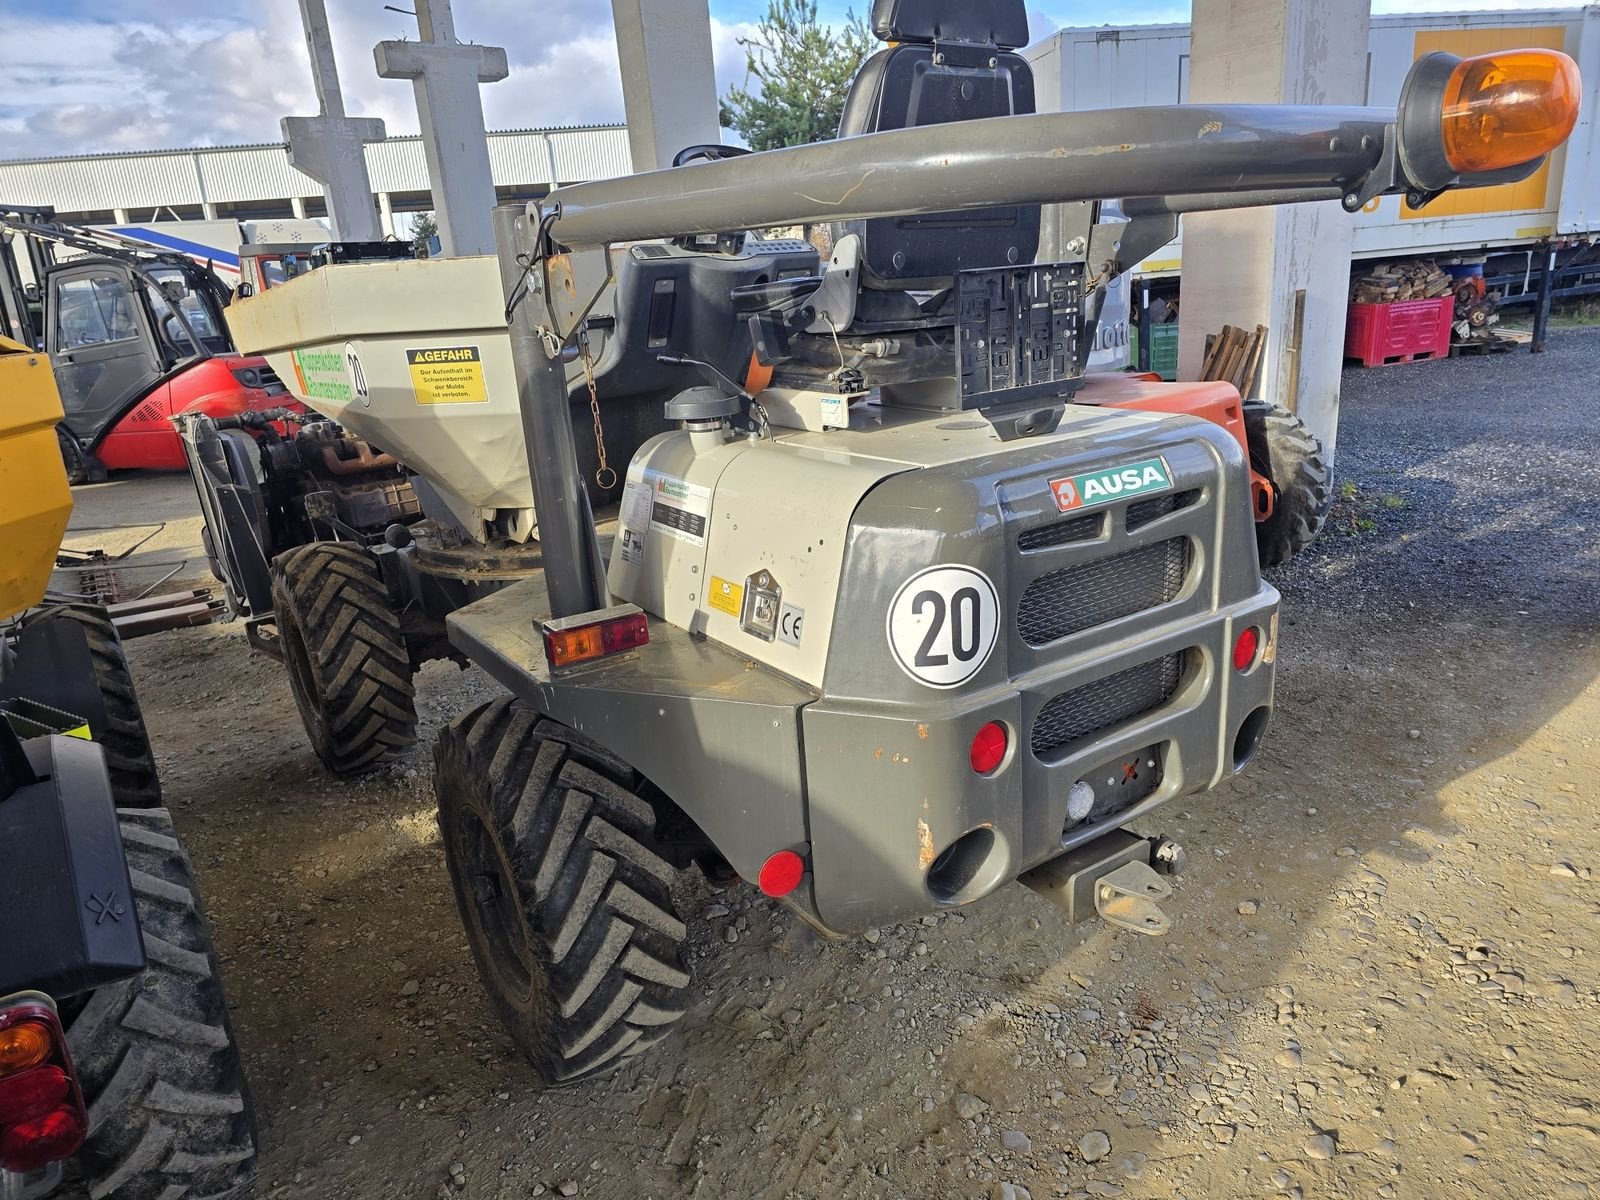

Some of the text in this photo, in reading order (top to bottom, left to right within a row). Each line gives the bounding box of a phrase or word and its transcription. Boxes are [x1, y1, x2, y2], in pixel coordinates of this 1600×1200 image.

[424, 349, 473, 362] GEFAHR
[347, 353, 368, 397] 20
[423, 375, 474, 383] Schwenkbereich
[432, 367, 464, 375] Aufenthalt
[1084, 466, 1165, 500] AUSA
[782, 612, 802, 640] CE
[911, 586, 981, 668] 20
